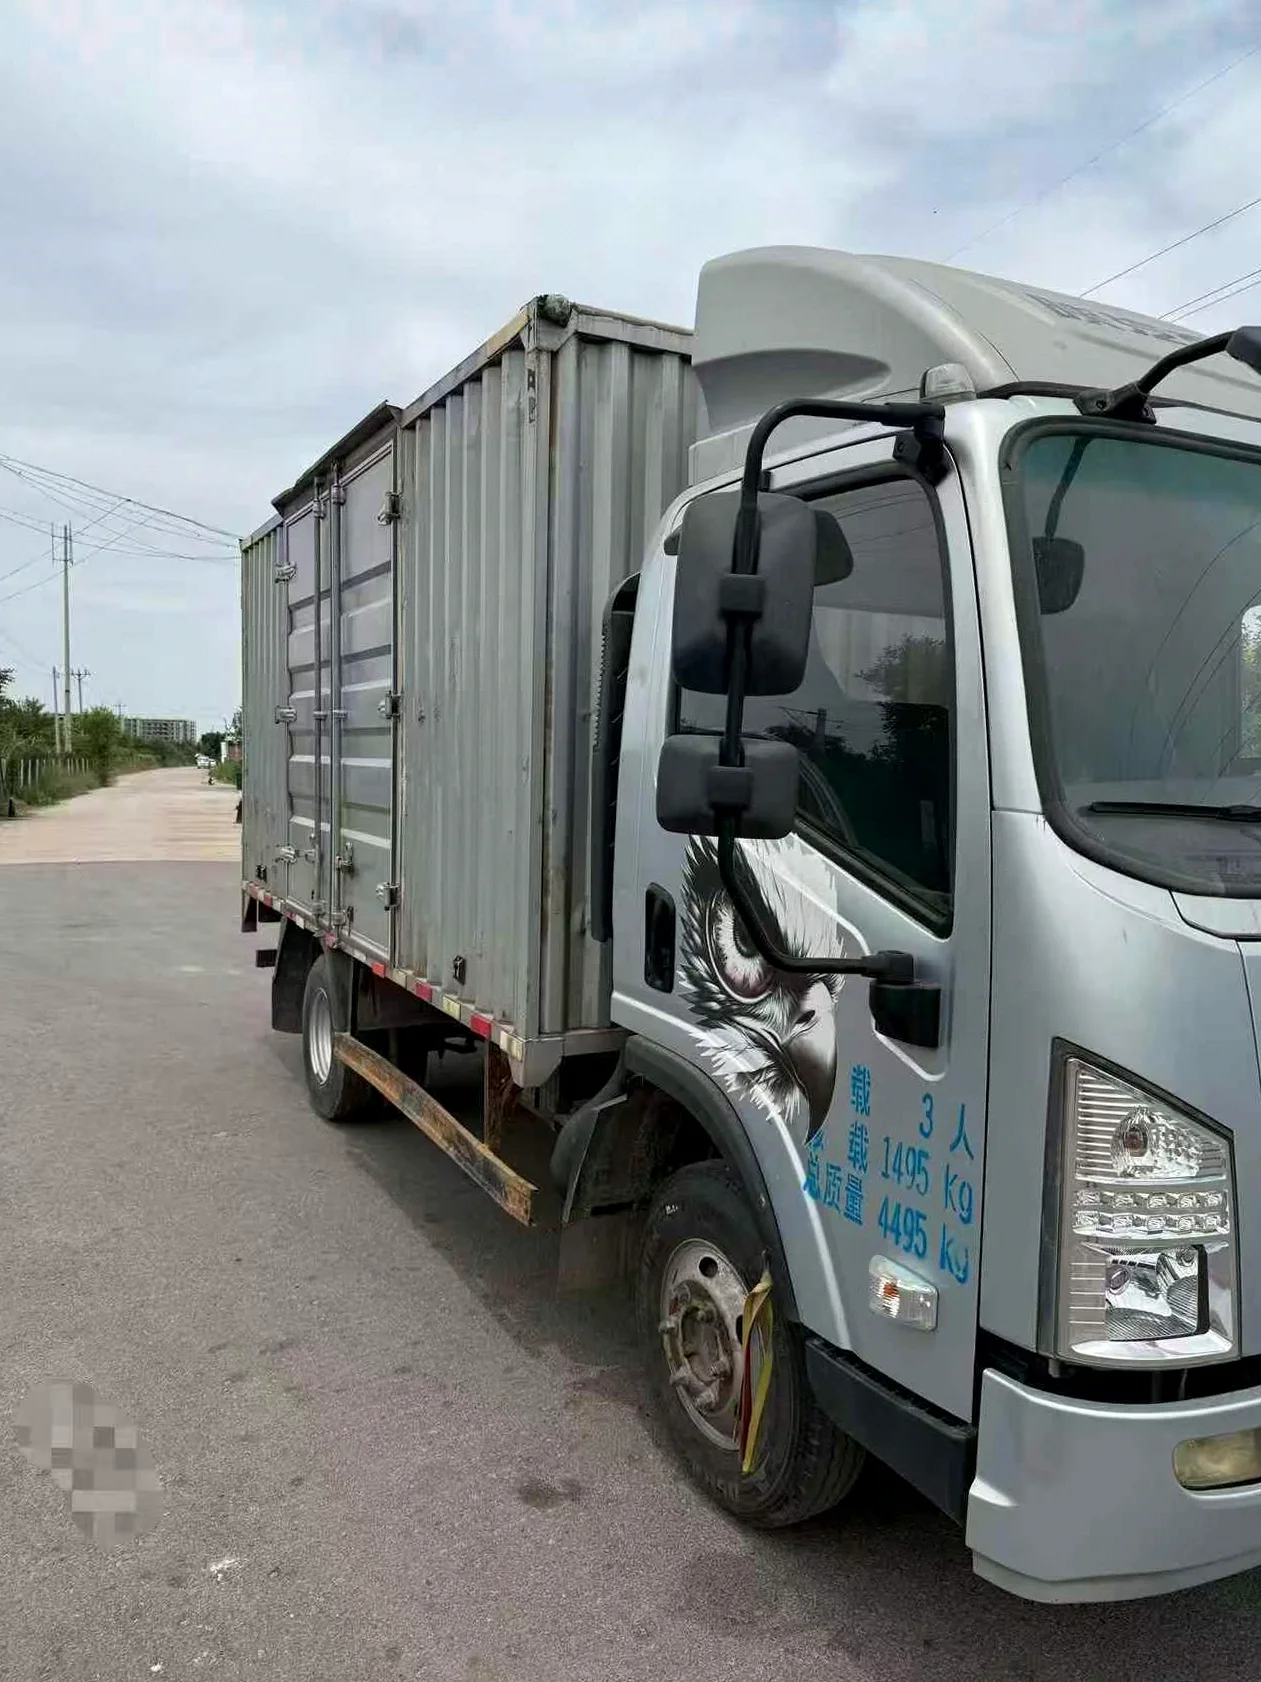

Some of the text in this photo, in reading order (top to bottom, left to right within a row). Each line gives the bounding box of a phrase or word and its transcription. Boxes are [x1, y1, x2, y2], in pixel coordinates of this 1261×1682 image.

[919, 1092, 934, 1139] 3
[950, 1103, 974, 1160] 人
[881, 1136, 931, 1196] 1495
[803, 1154, 863, 1226] 总质量
[878, 1196, 927, 1259] 4495
